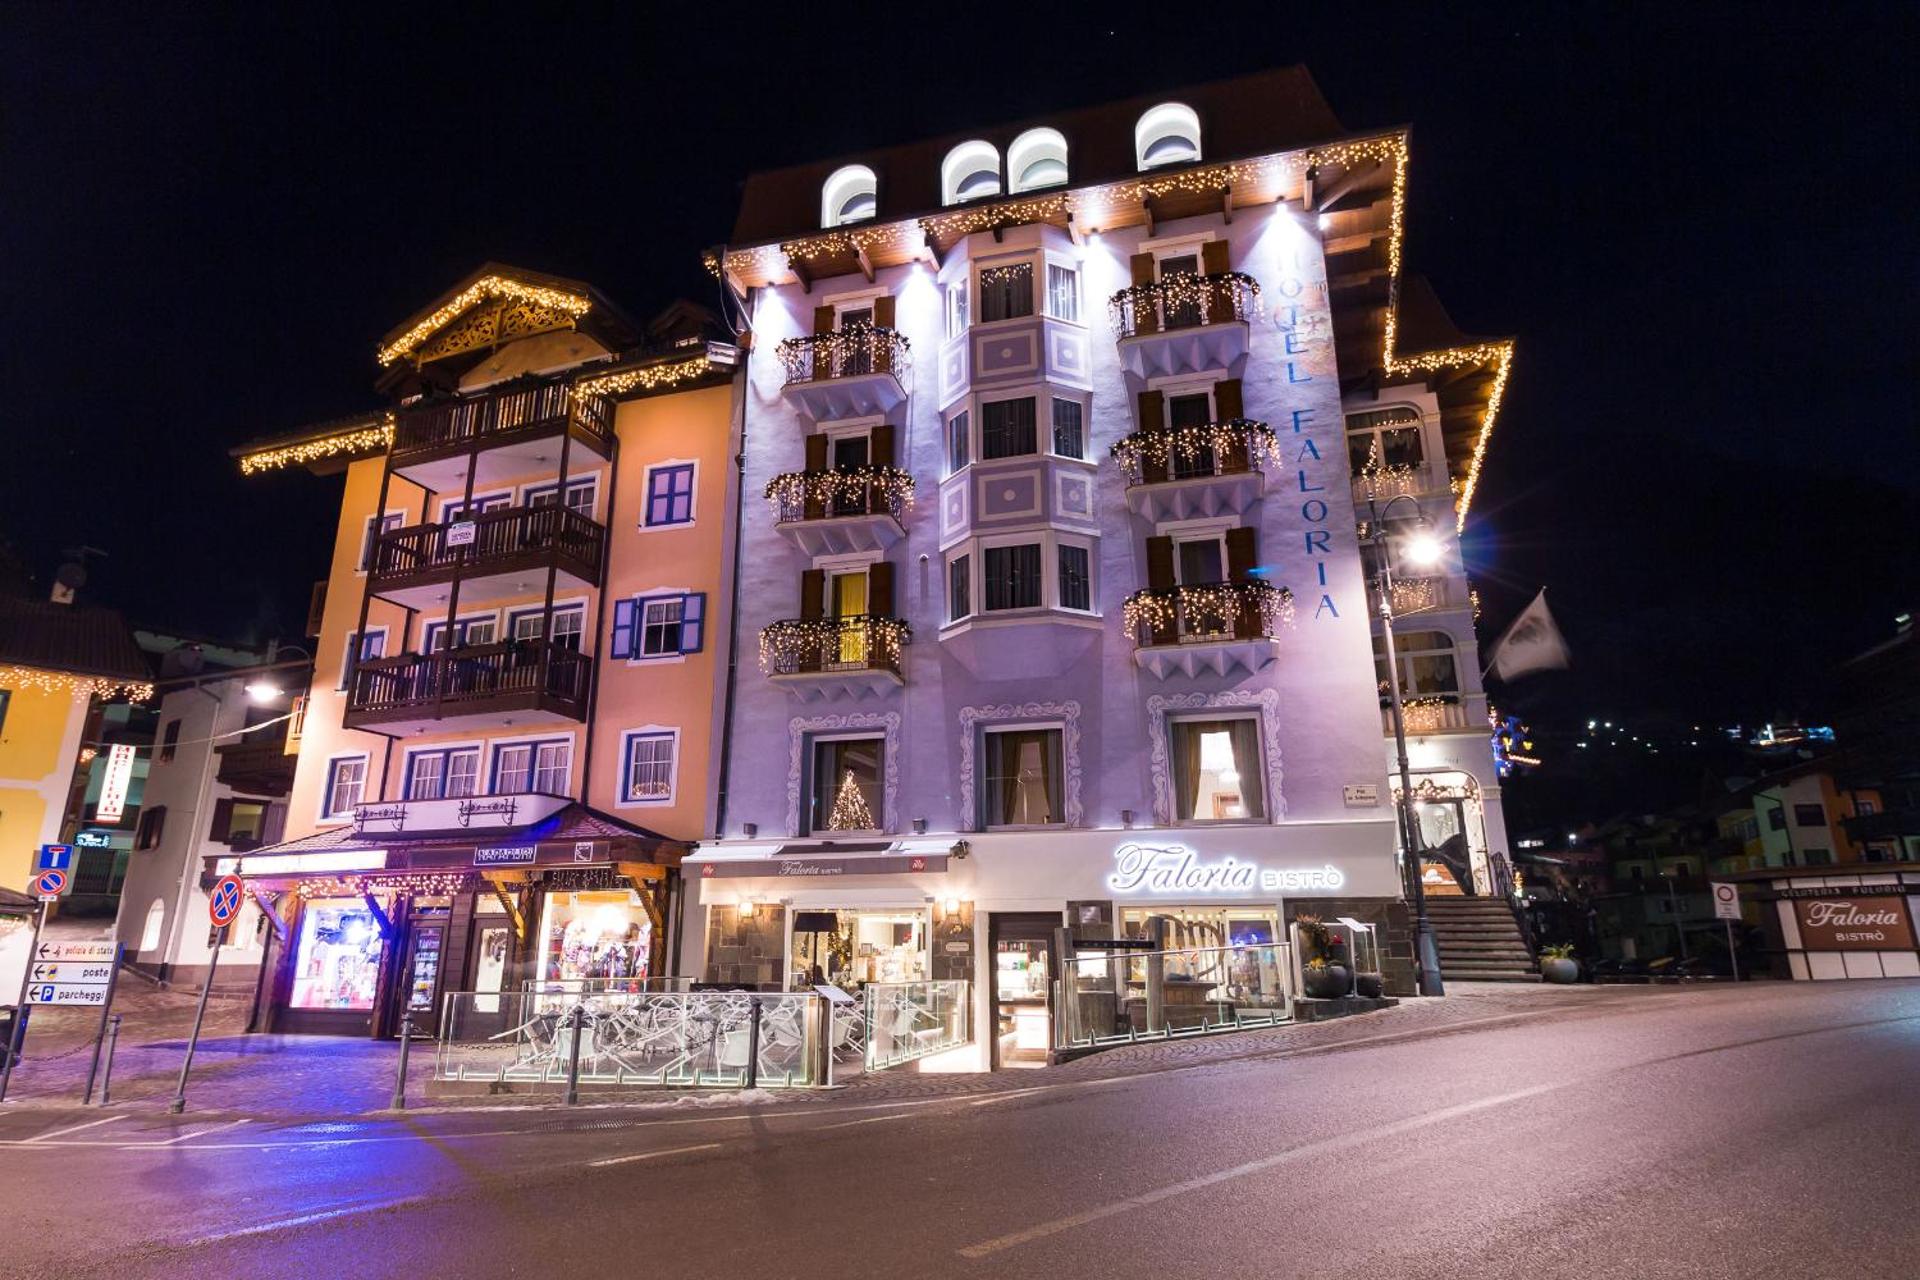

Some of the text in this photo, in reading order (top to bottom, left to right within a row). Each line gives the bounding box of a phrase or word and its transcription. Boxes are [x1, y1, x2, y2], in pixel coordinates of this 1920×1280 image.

[1292, 408, 1339, 619] FALORIA
[778, 861, 819, 875] Faloria
[1112, 844, 1341, 889] Faloria BISTRÒ
[1807, 901, 1898, 927] Faloria
[1835, 930, 1885, 941] BISTRÒ
[82, 967, 109, 978] poste
[58, 989, 105, 1002] parcheggi
